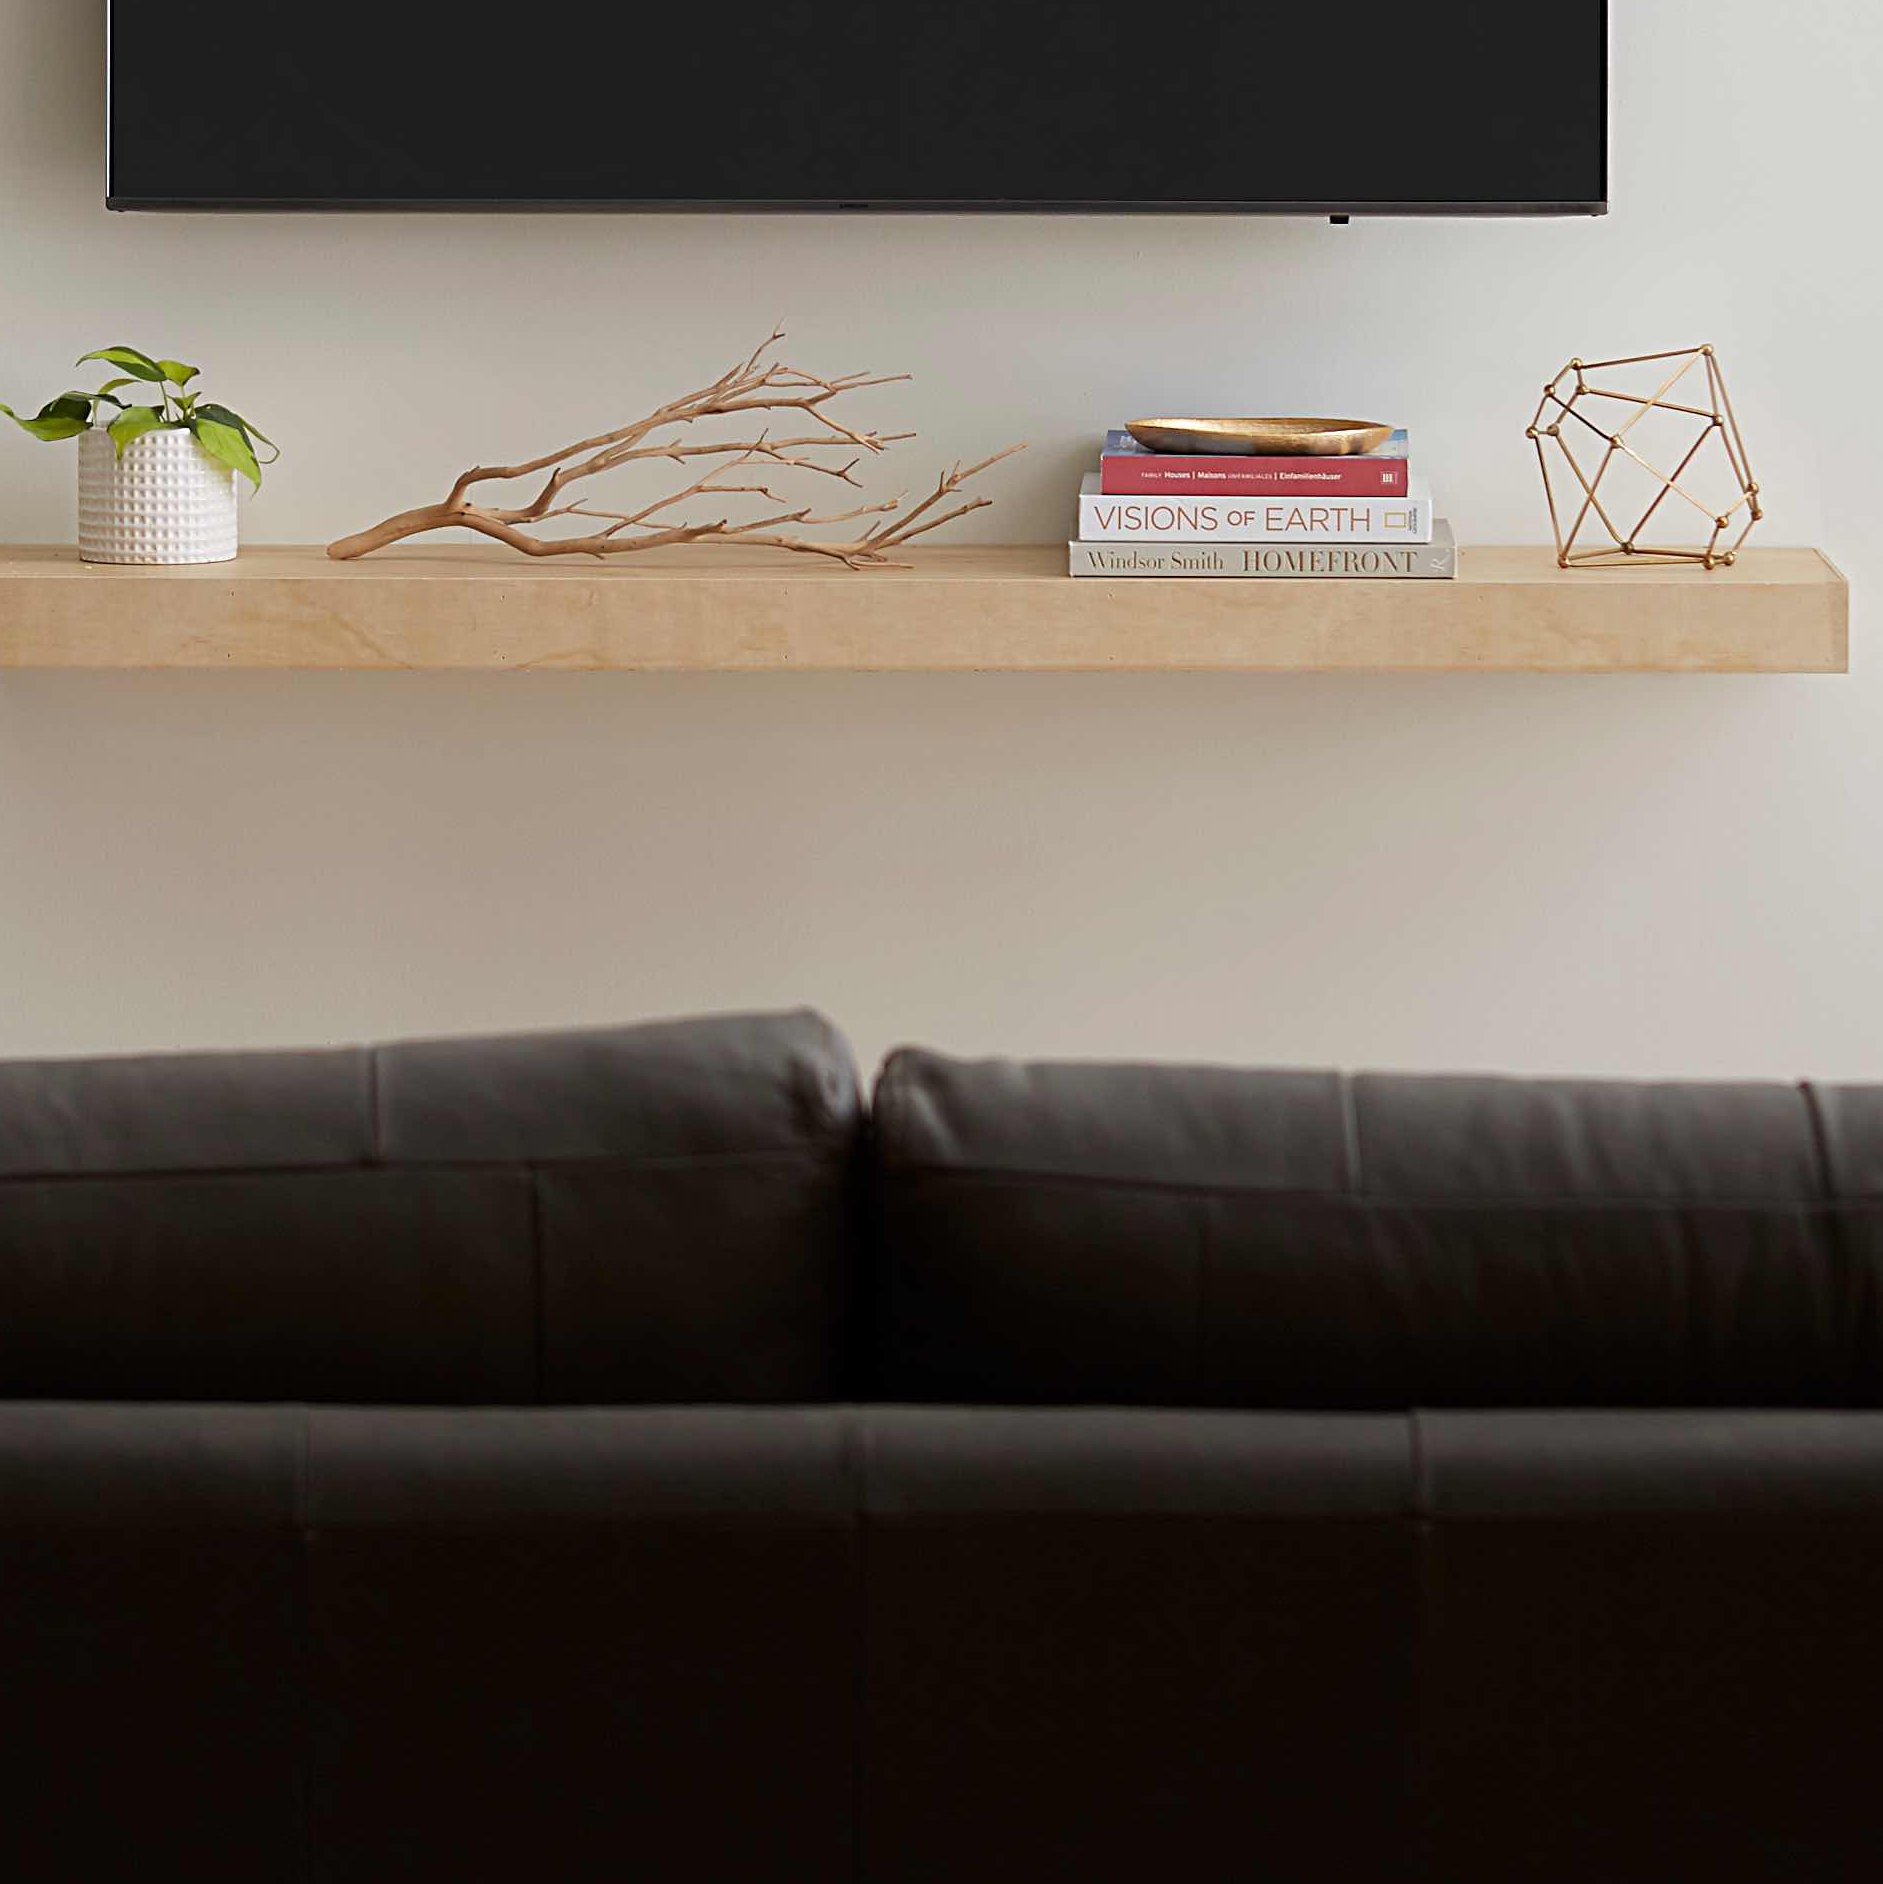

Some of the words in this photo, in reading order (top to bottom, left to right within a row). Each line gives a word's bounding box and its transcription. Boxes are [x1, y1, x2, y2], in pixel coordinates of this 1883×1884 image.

[1164, 471, 1191, 479] Houses
[1197, 471, 1227, 480] Maisons
[1093, 505, 1218, 531] VISIONS
[1226, 510, 1256, 526] OF
[1265, 507, 1371, 532] EARTH
[1087, 550, 1165, 570] Windsor
[1170, 550, 1224, 570] Smith
[1242, 549, 1418, 573] HOMEFRONT
